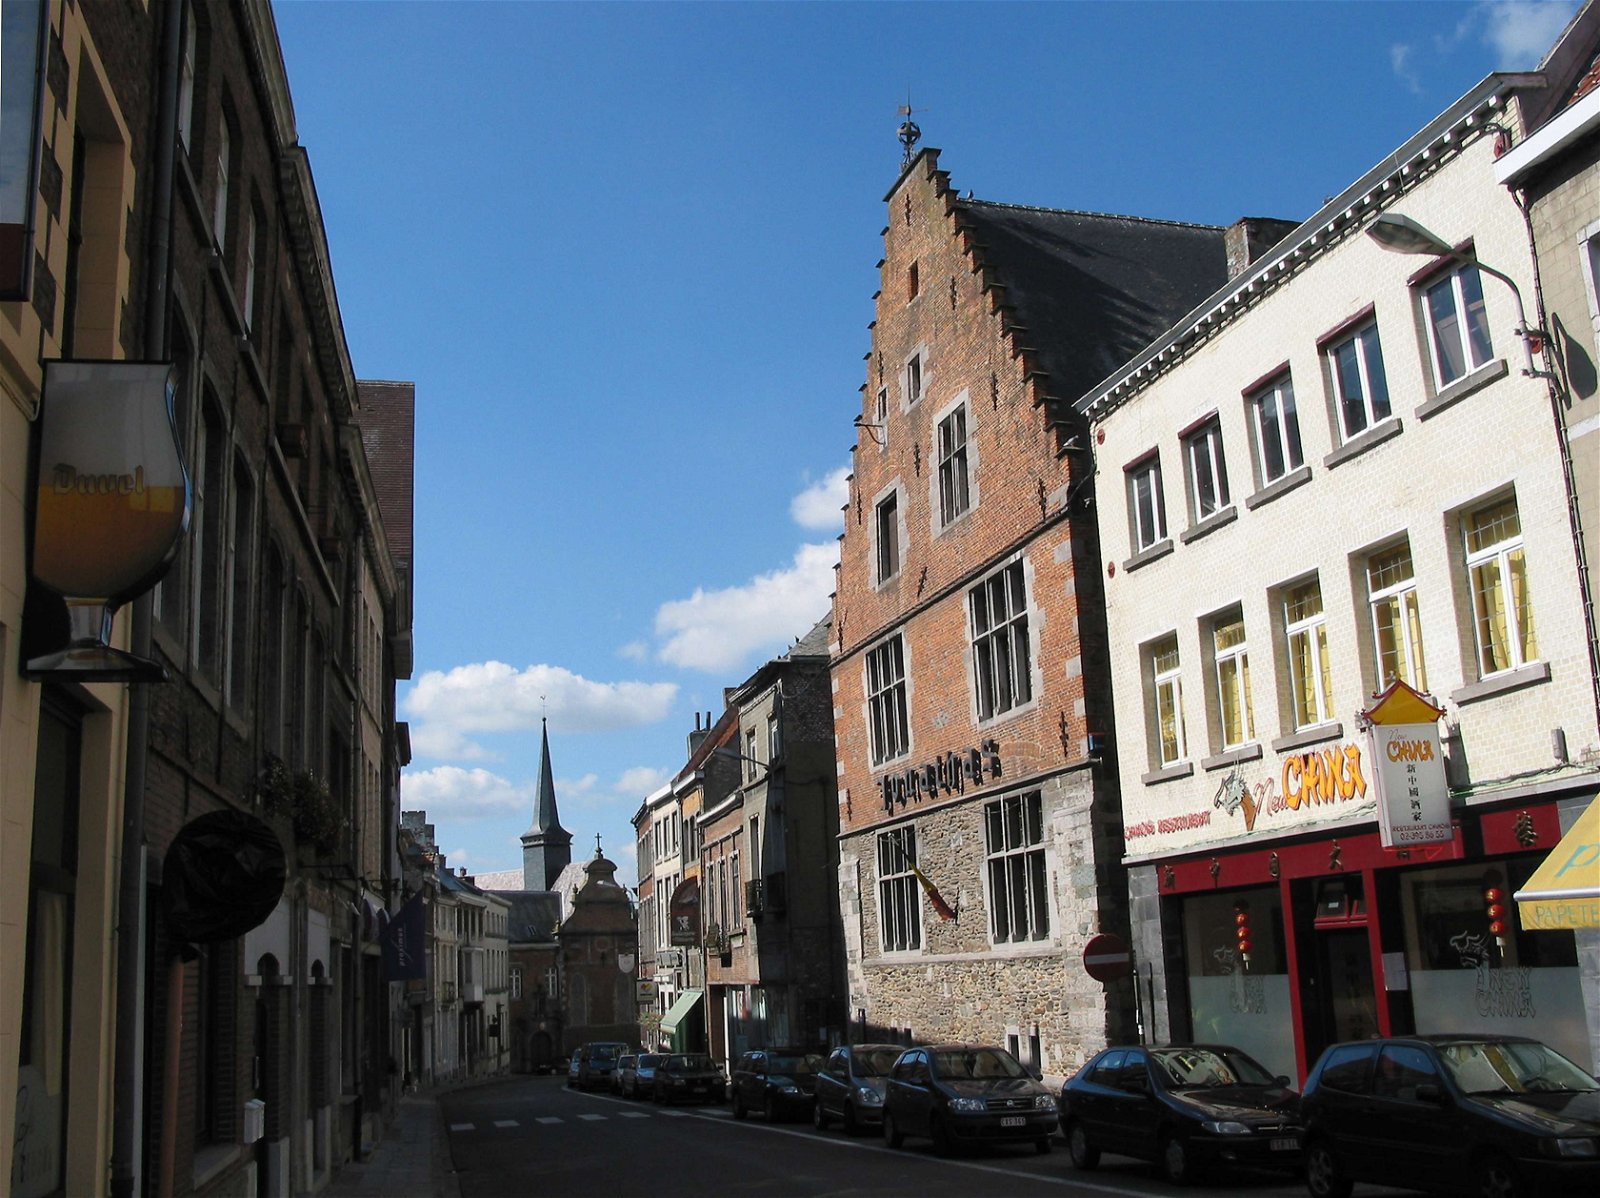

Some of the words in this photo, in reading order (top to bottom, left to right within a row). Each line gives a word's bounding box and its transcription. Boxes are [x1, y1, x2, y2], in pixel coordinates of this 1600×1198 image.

[52, 462, 147, 496] Duvel
[1386, 739, 1435, 764] CHINA
[1281, 742, 1367, 811] CHINA
